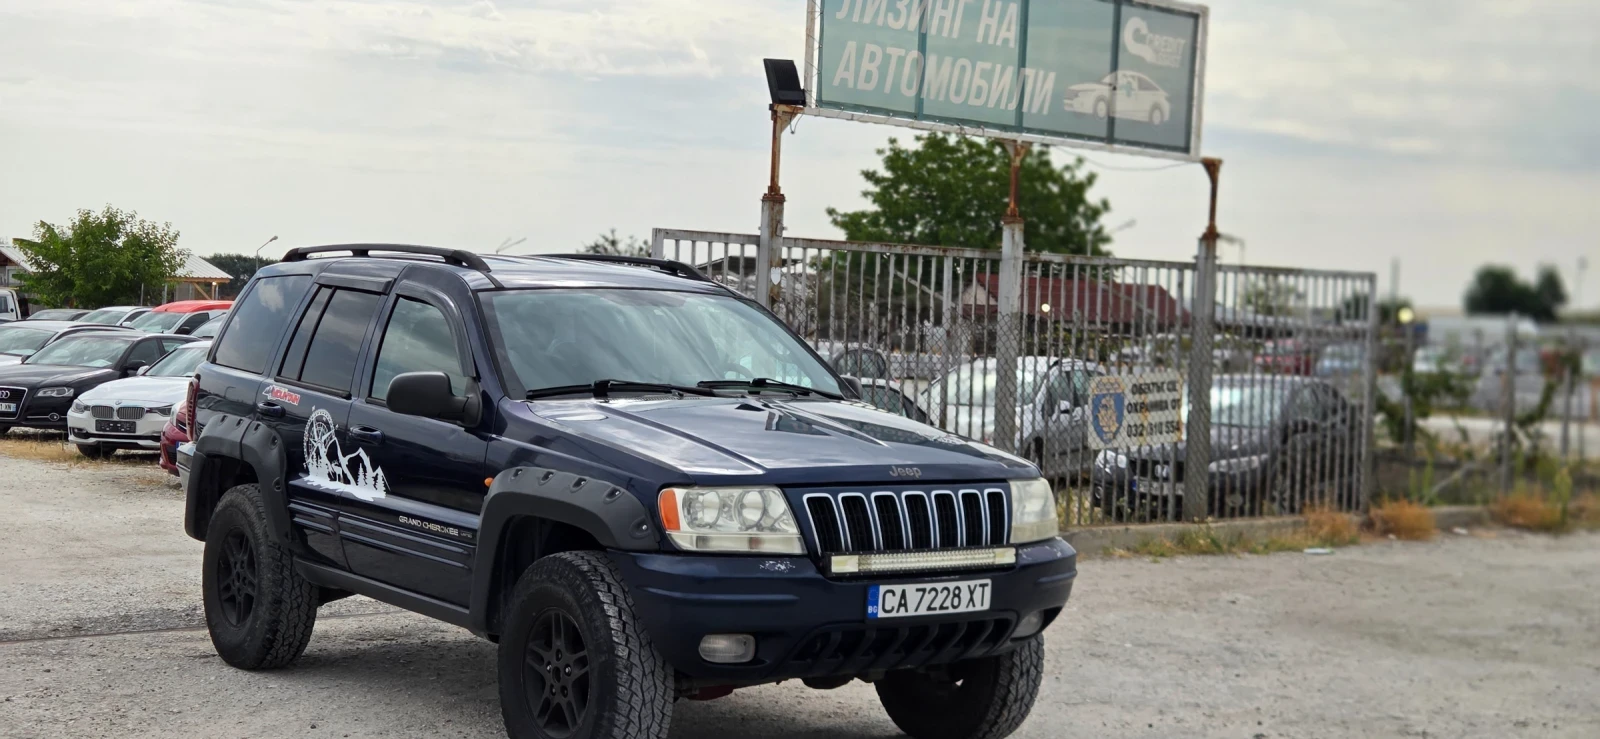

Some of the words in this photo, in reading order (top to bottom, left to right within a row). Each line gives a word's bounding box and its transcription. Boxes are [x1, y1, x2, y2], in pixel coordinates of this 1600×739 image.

[976, 0, 1018, 48] НА
[832, 41, 1057, 115] АВТОМОБИЛИ
[1126, 423, 1145, 438] 032
[889, 465, 922, 478] Jeep
[399, 515, 421, 527] GRAND
[422, 521, 459, 537] CHEROKEE
[868, 605, 878, 614] BG
[881, 588, 909, 614] CA
[914, 585, 962, 612] 7228
[966, 583, 989, 608] XT
